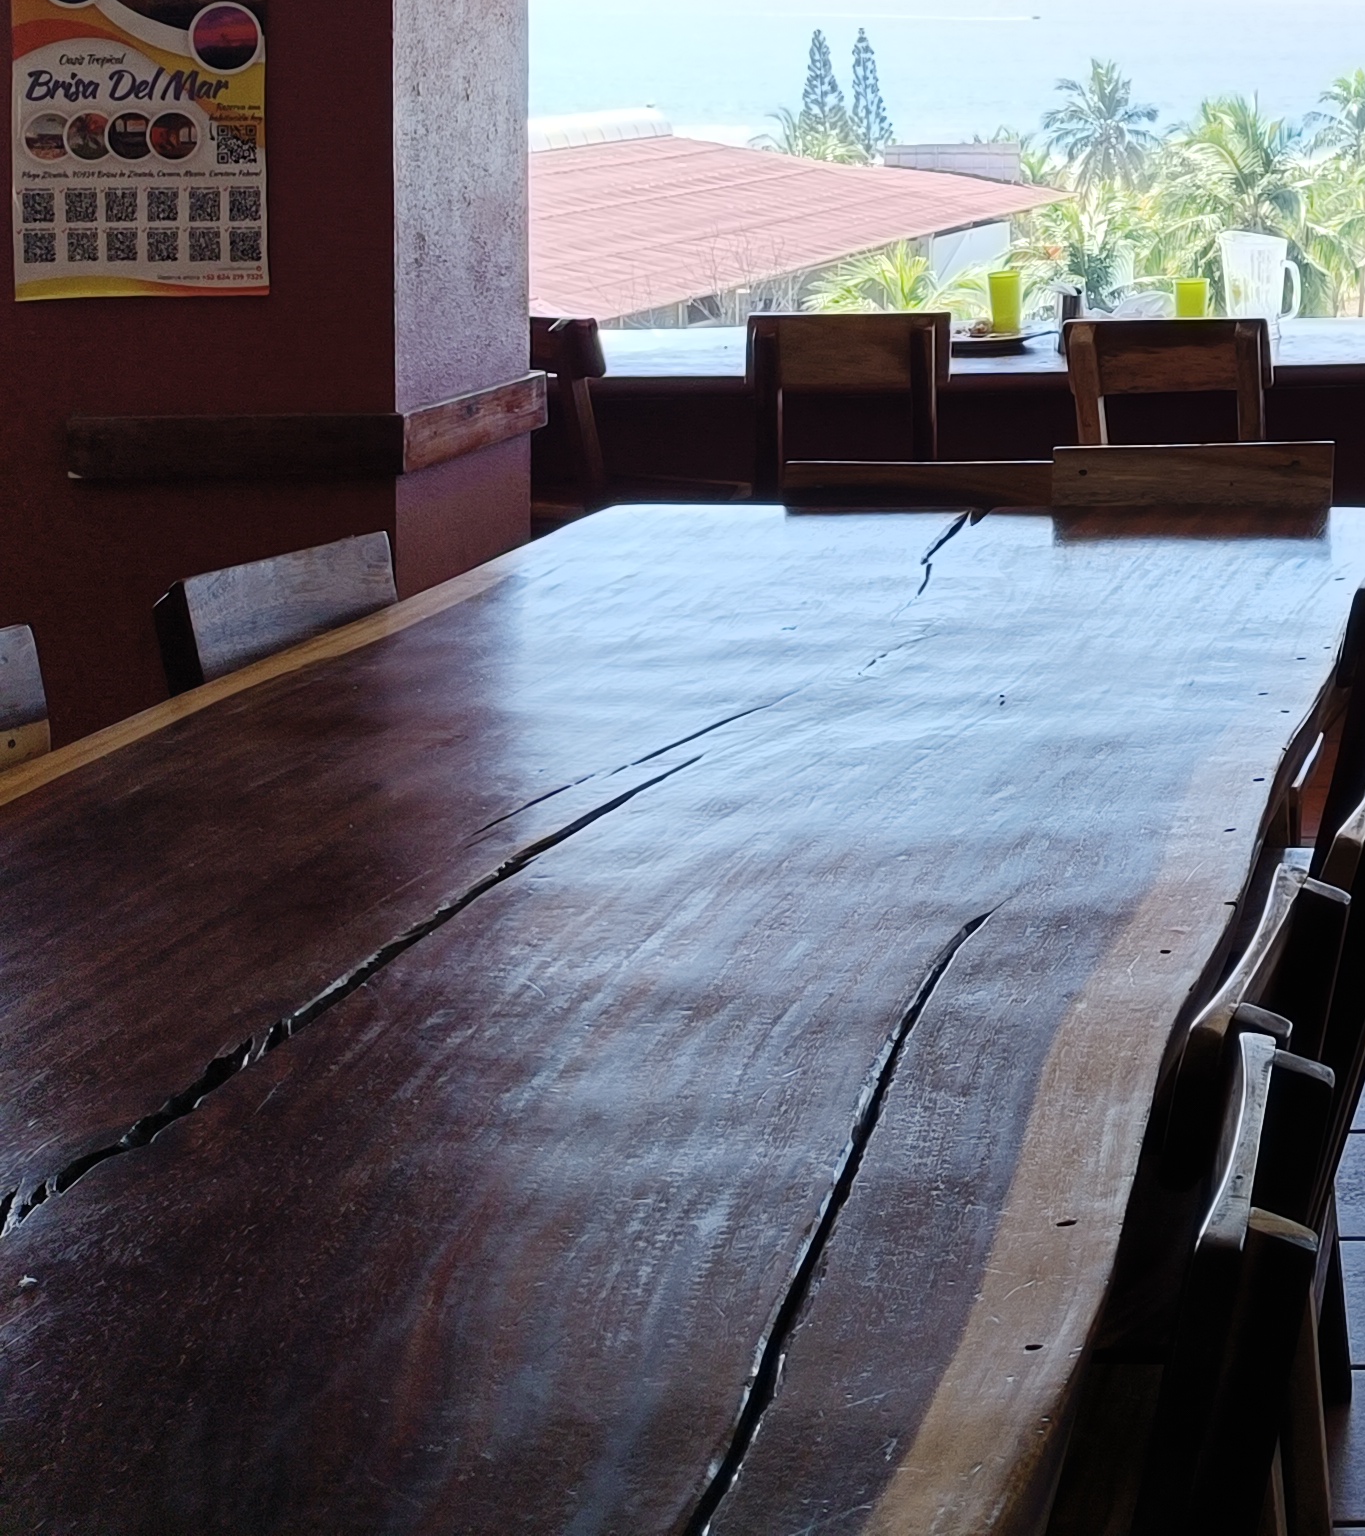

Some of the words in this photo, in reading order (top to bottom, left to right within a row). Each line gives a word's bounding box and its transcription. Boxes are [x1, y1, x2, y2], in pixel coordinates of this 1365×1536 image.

[25, 69, 101, 103] Brisa
[108, 67, 163, 103] Del
[160, 70, 230, 102] Mar
